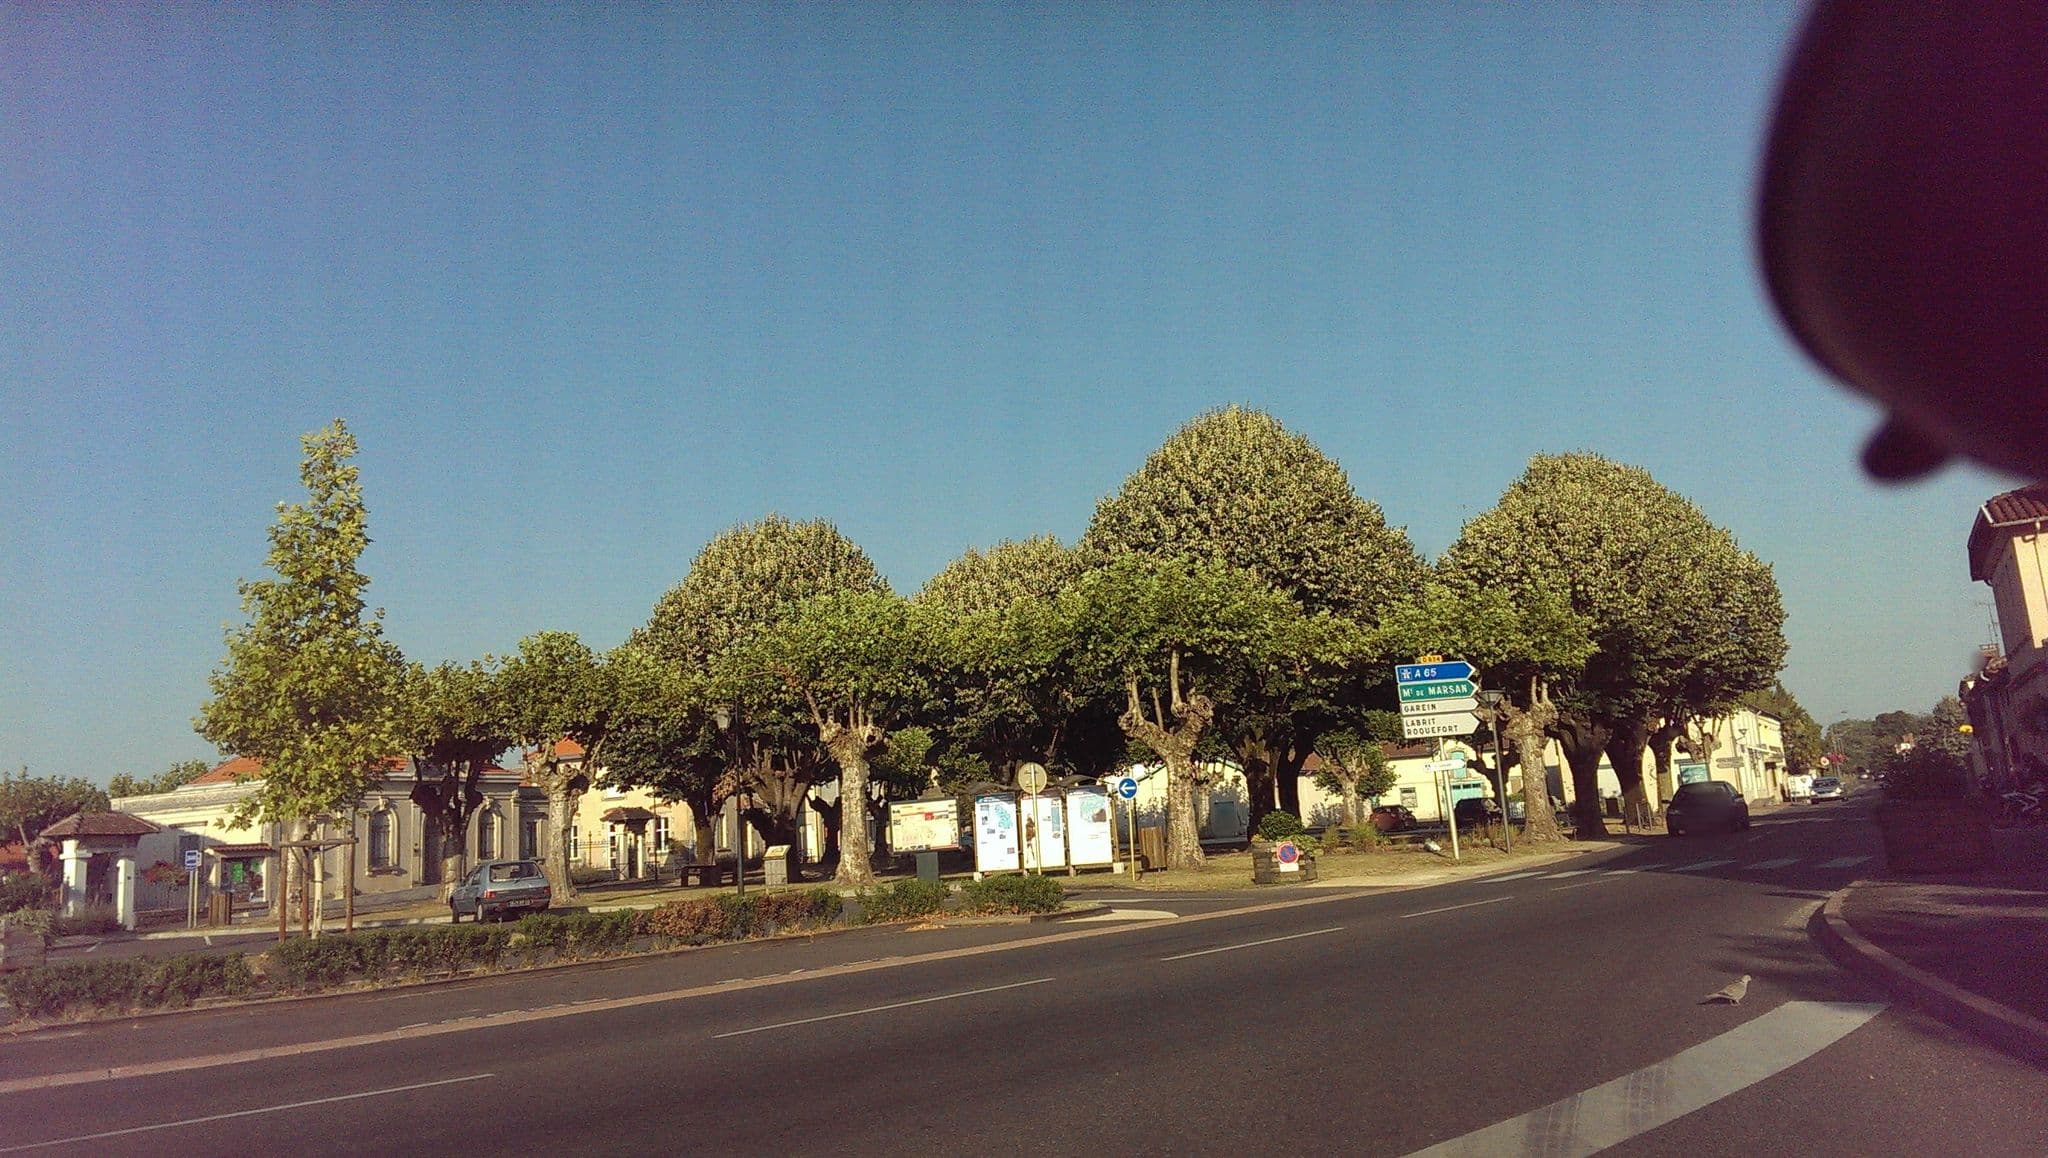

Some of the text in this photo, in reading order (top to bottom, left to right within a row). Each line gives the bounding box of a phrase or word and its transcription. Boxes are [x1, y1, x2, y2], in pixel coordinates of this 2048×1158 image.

[1414, 668, 1437, 678] A 65
[1428, 684, 1468, 696] MARSAN
[1404, 703, 1436, 713] GAREIN
[1405, 718, 1436, 727] LABRIT
[1407, 725, 1458, 735] ROQUEFORT
